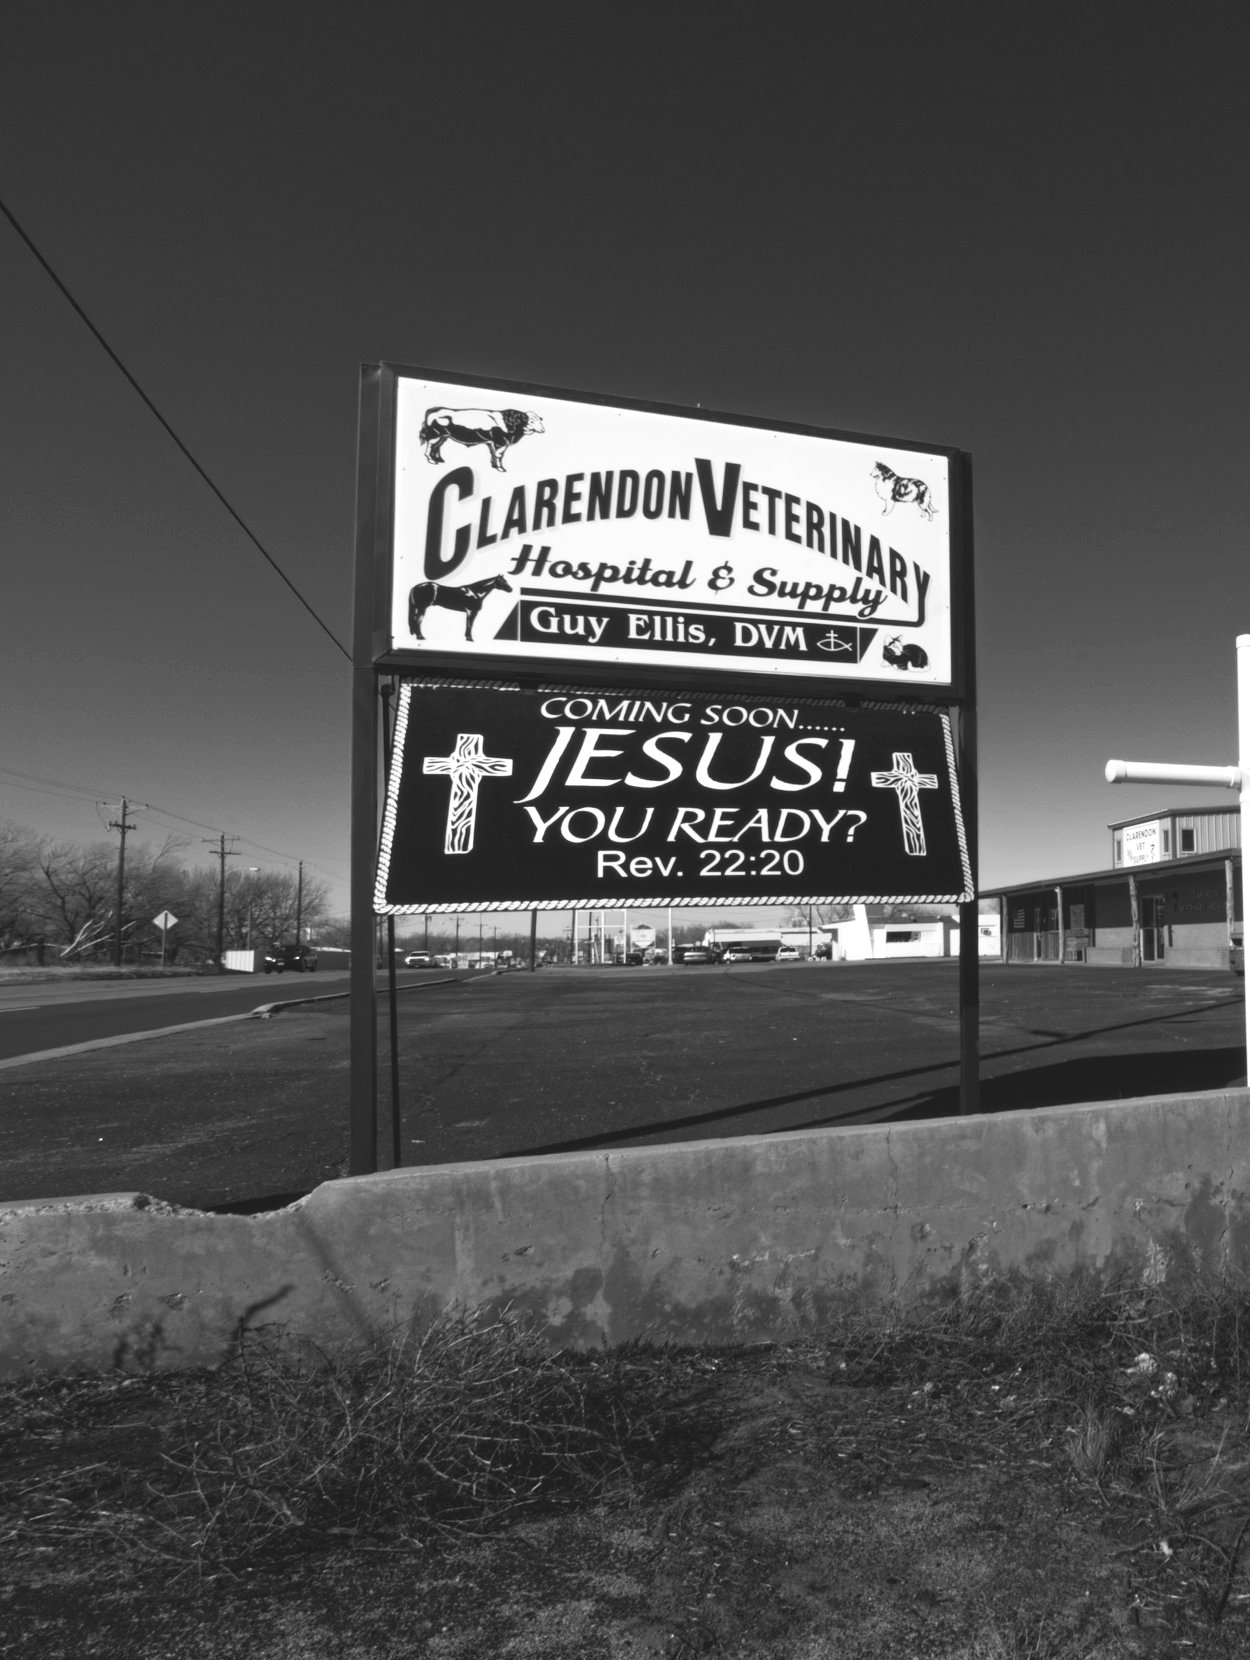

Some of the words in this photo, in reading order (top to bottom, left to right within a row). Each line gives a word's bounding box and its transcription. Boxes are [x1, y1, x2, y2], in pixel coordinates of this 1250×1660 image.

[423, 466, 694, 581] CLARENDON
[694, 457, 931, 605] VETERINARY
[507, 544, 695, 592] Hospital
[708, 561, 735, 592] &
[747, 567, 888, 618] Supply
[529, 606, 610, 644] Guy
[627, 613, 716, 647] Ellis,
[733, 621, 808, 652] DVM
[540, 696, 692, 724] COMING
[513, 726, 856, 804] JESUS!
[523, 806, 655, 844] YOU
[666, 807, 868, 844] READY?
[1126, 827, 1157, 841] CLARENDON
[597, 850, 684, 878] Rev.
[699, 849, 805, 877] 22:20
